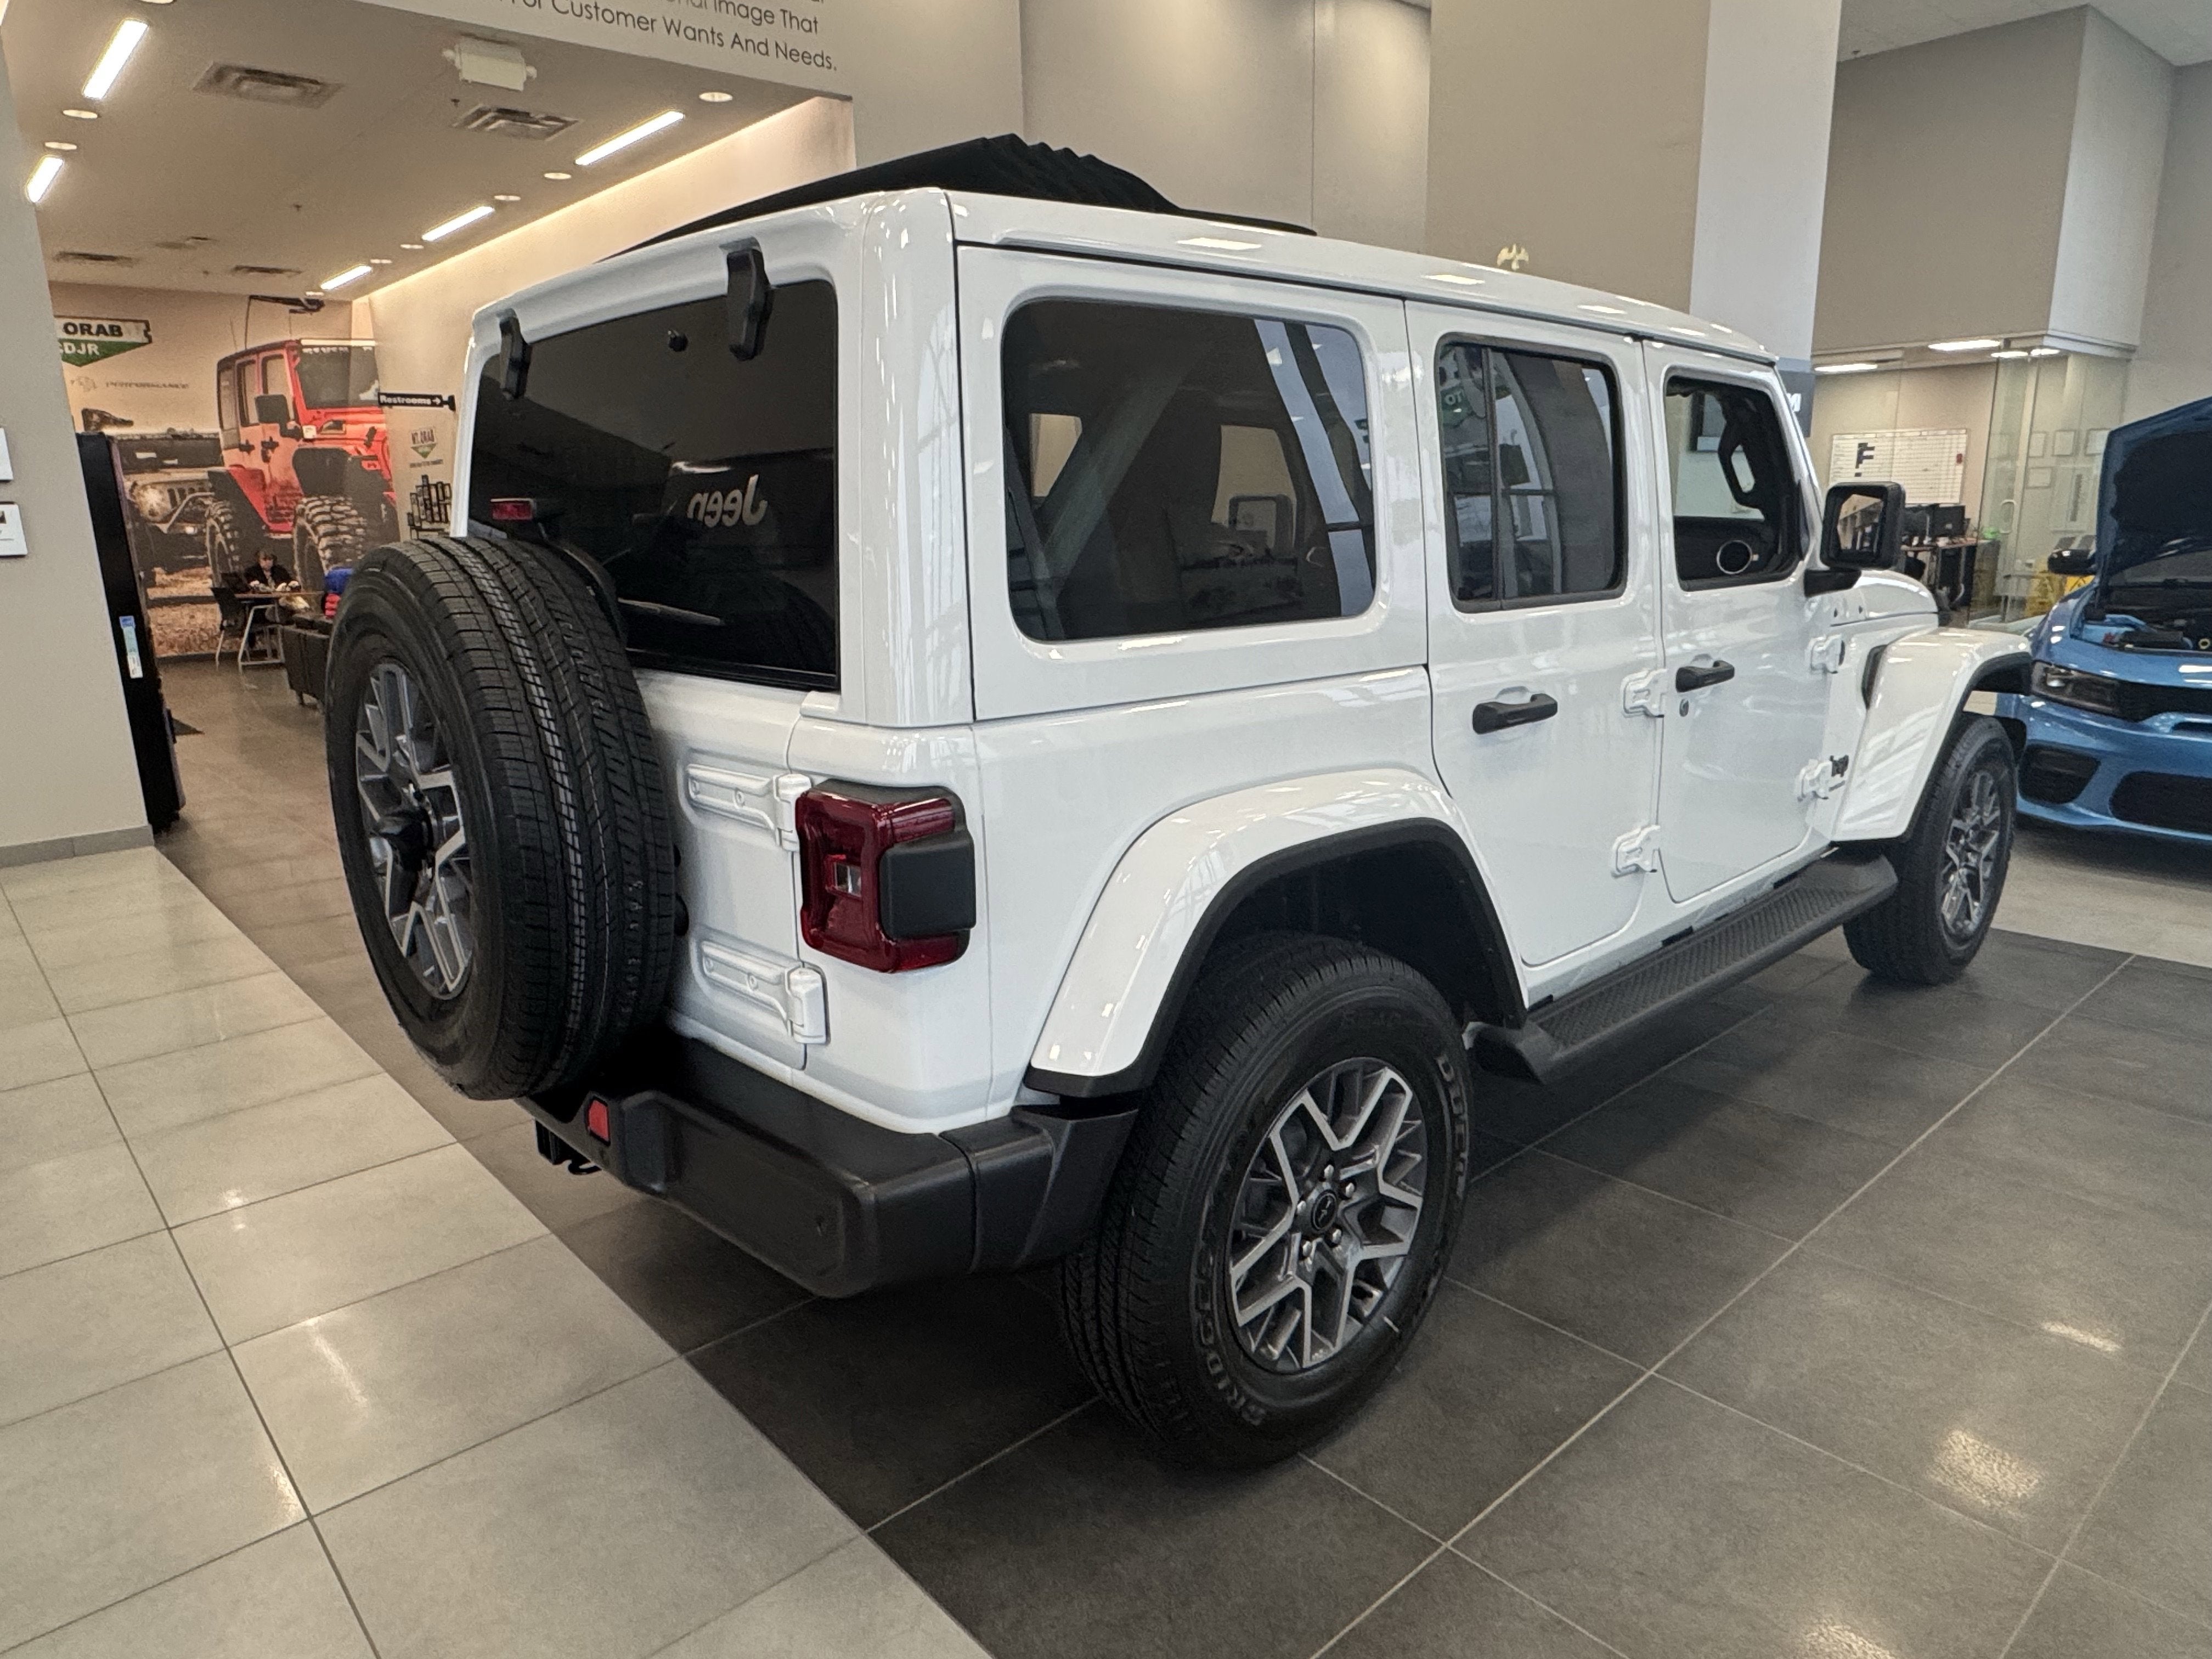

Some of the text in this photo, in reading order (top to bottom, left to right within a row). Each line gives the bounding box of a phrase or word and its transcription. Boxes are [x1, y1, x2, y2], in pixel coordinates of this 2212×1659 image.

[714, 0, 818, 34] Image That
[552, 0, 837, 71] Customer Wants And Needs.
[63, 321, 123, 337] ORAB
[380, 395, 432, 405] Restrooms
